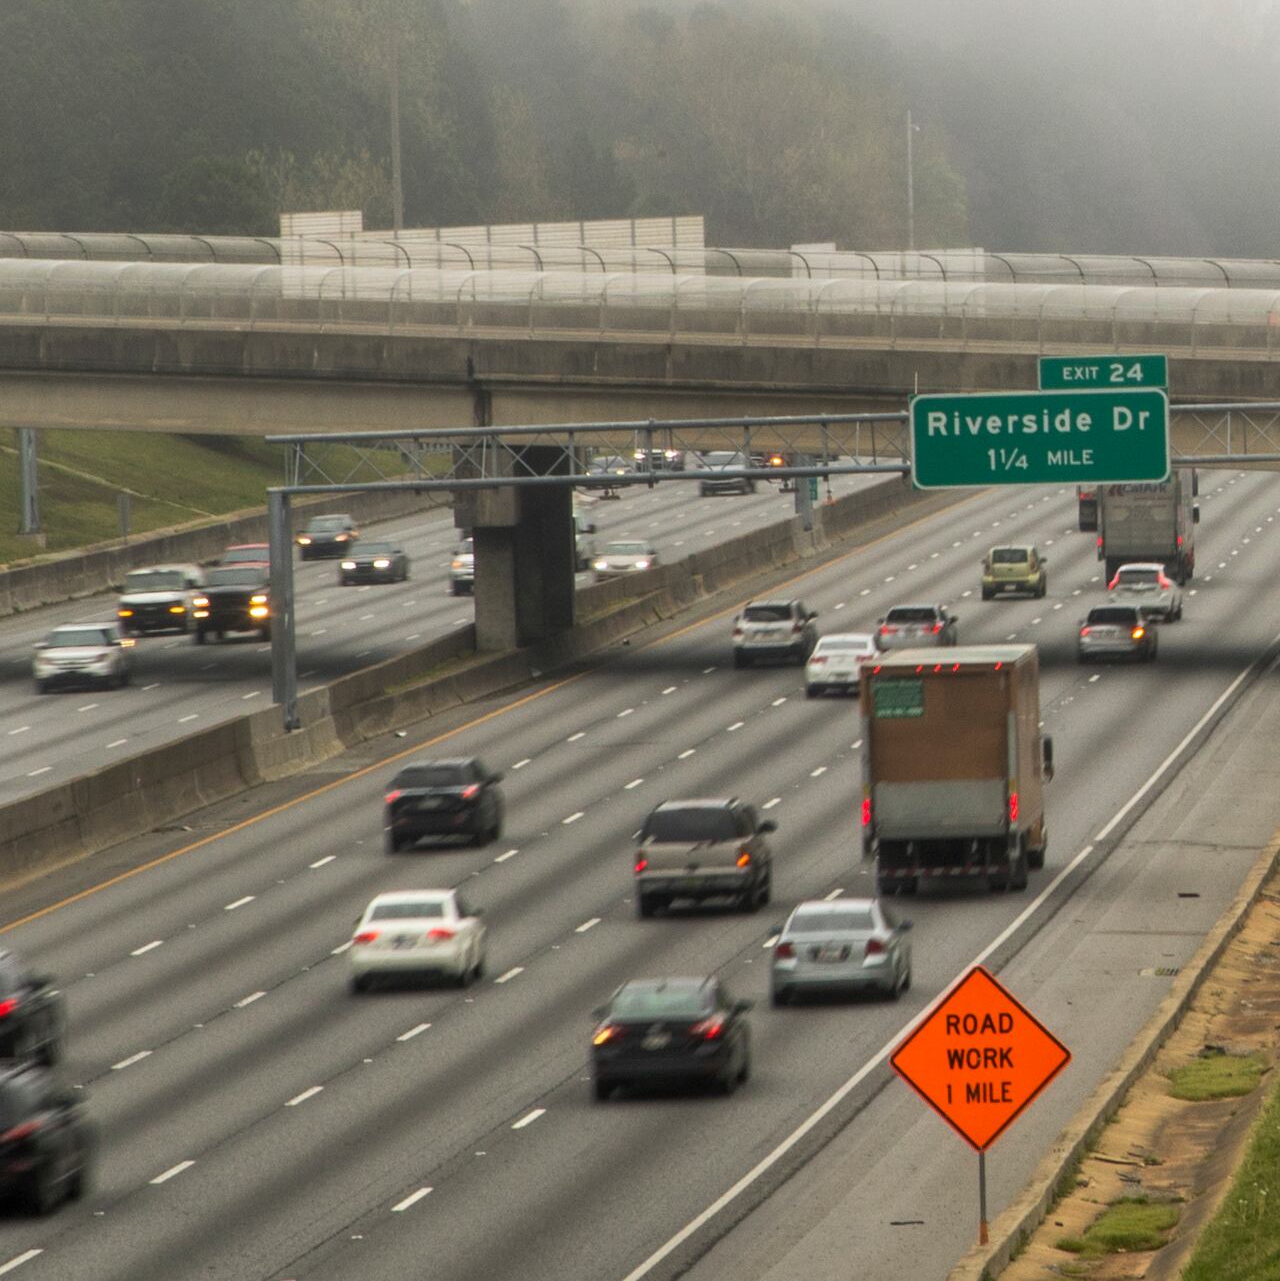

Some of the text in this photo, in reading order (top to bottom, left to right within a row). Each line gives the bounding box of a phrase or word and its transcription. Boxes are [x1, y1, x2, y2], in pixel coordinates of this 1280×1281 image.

[1063, 363, 1144, 383] EXIT 24
[927, 406, 1150, 437] Riverside Dr
[1047, 449, 1094, 466] MILE
[946, 1012, 1014, 1035] ROAD
[946, 1047, 1014, 1070] WORK
[947, 1081, 1013, 1105] 1 MILE
